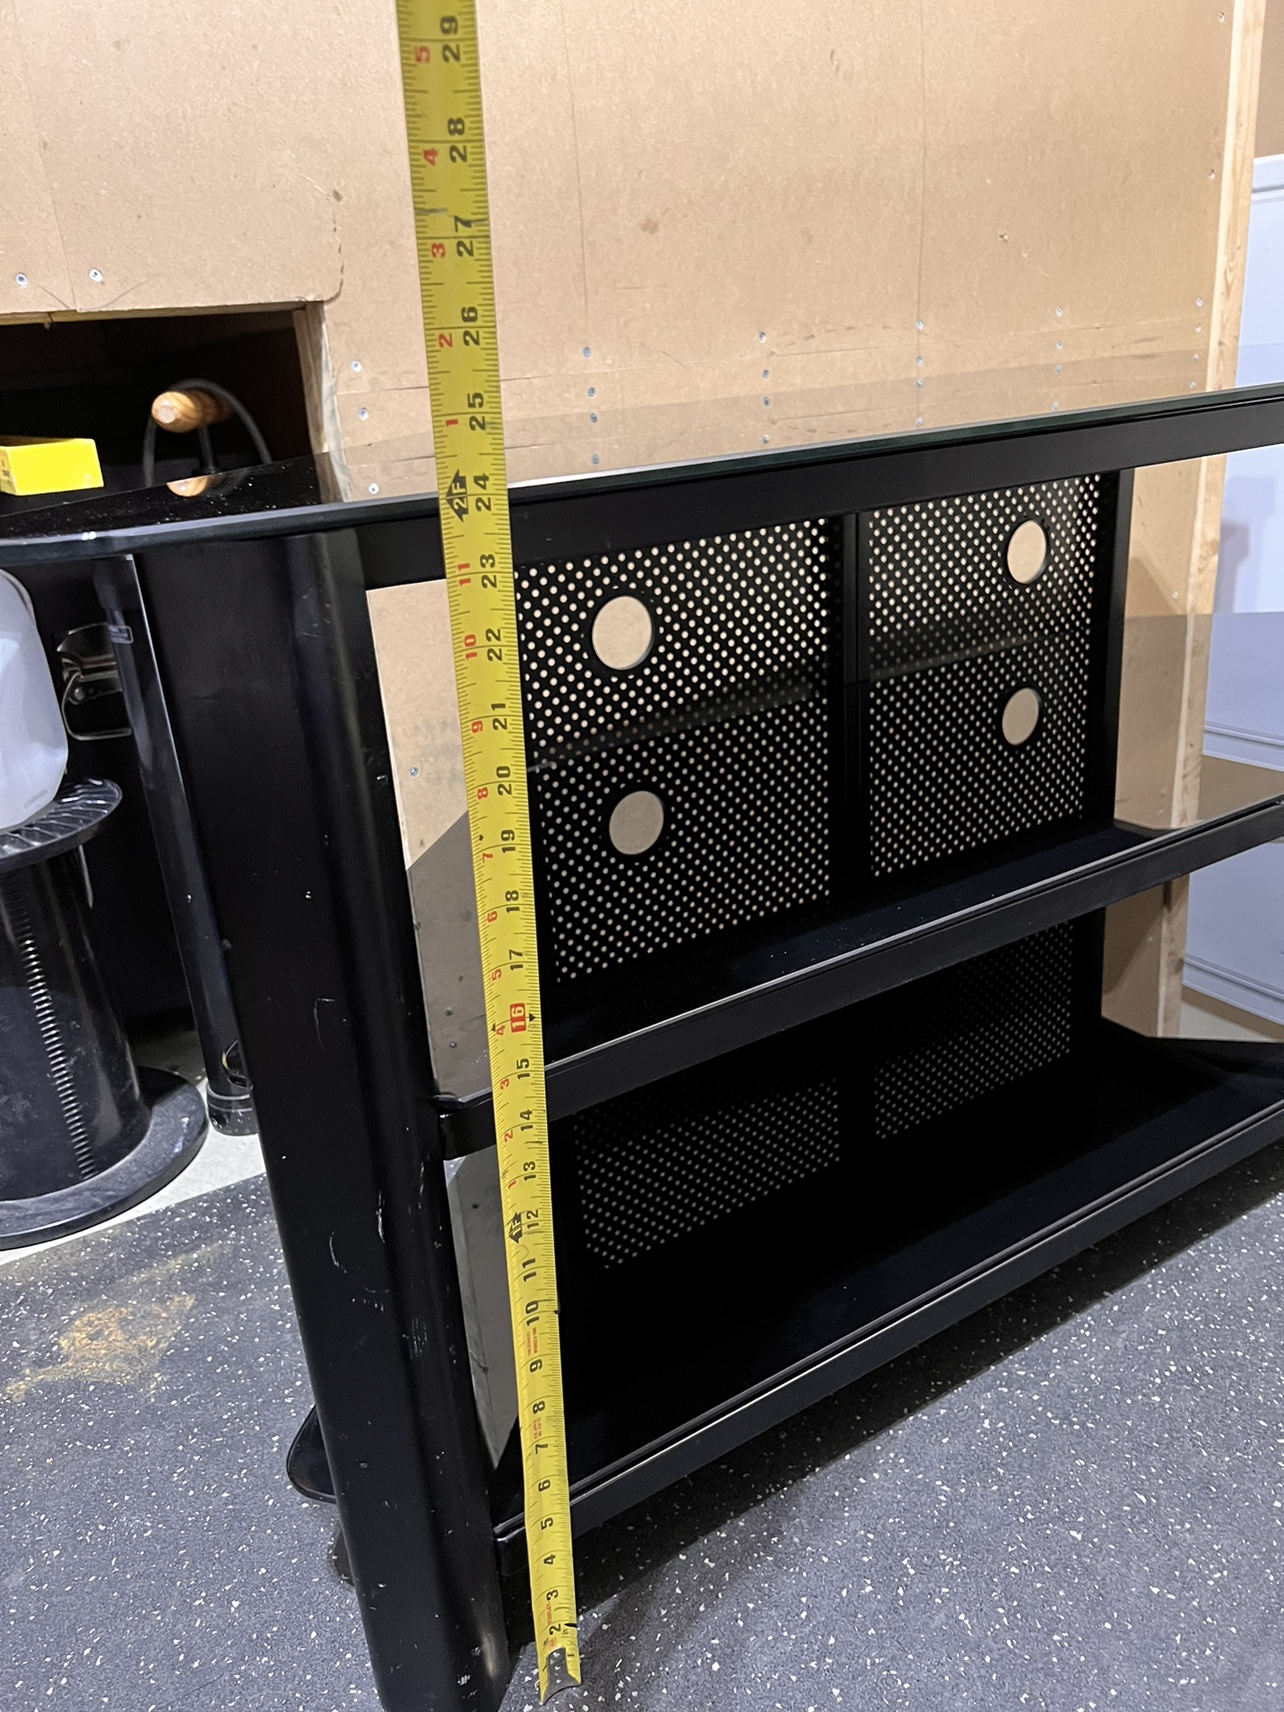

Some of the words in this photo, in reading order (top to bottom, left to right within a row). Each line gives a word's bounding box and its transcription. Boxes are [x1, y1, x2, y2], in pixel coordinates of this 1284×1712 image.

[440, 15, 461, 63] 29
[414, 46, 430, 64] 5
[448, 118, 468, 163] 28
[423, 147, 439, 166] 4
[454, 215, 474, 257] 27
[431, 243, 446, 258] 3
[461, 306, 480, 346] 26
[438, 333, 453, 348] 2
[467, 392, 486, 431] 25
[445, 419, 458, 428] 1
[452, 482, 468, 511] 2F
[473, 473, 492, 512] 24
[457, 563, 471, 587] 11
[480, 554, 497, 589] 23
[464, 634, 478, 660] 10
[485, 628, 503, 662] 22
[491, 703, 508, 730] 21
[471, 720, 483, 734] 9
[496, 766, 512, 795] 20
[477, 787, 489, 800] 8
[501, 830, 516, 853] 19
[482, 853, 493, 863] 7
[505, 890, 520, 913] 18
[487, 911, 498, 923] 6
[509, 949, 523, 971] 17
[491, 968, 502, 981] 5
[511, 1006, 525, 1029] 16
[496, 1025, 505, 1036] 4
[516, 1058, 530, 1079] 15
[500, 1078, 509, 1090] 3
[520, 1109, 533, 1131] 14
[503, 1130, 513, 1142] 2
[523, 1161, 536, 1181] 13
[507, 1180, 517, 1189] 1
[526, 1209, 539, 1229] 12
[522, 1258, 536, 1282] 11
[525, 1301, 539, 1326] 10
[530, 1359, 542, 1373] 9
[532, 1401, 545, 1414] 8
[535, 1443, 549, 1455] 7
[538, 1479, 551, 1492] 6
[540, 1517, 554, 1531] 5
[543, 1554, 556, 1565] 4
[546, 1589, 559, 1601] 3
[549, 1623, 561, 1635] 2
